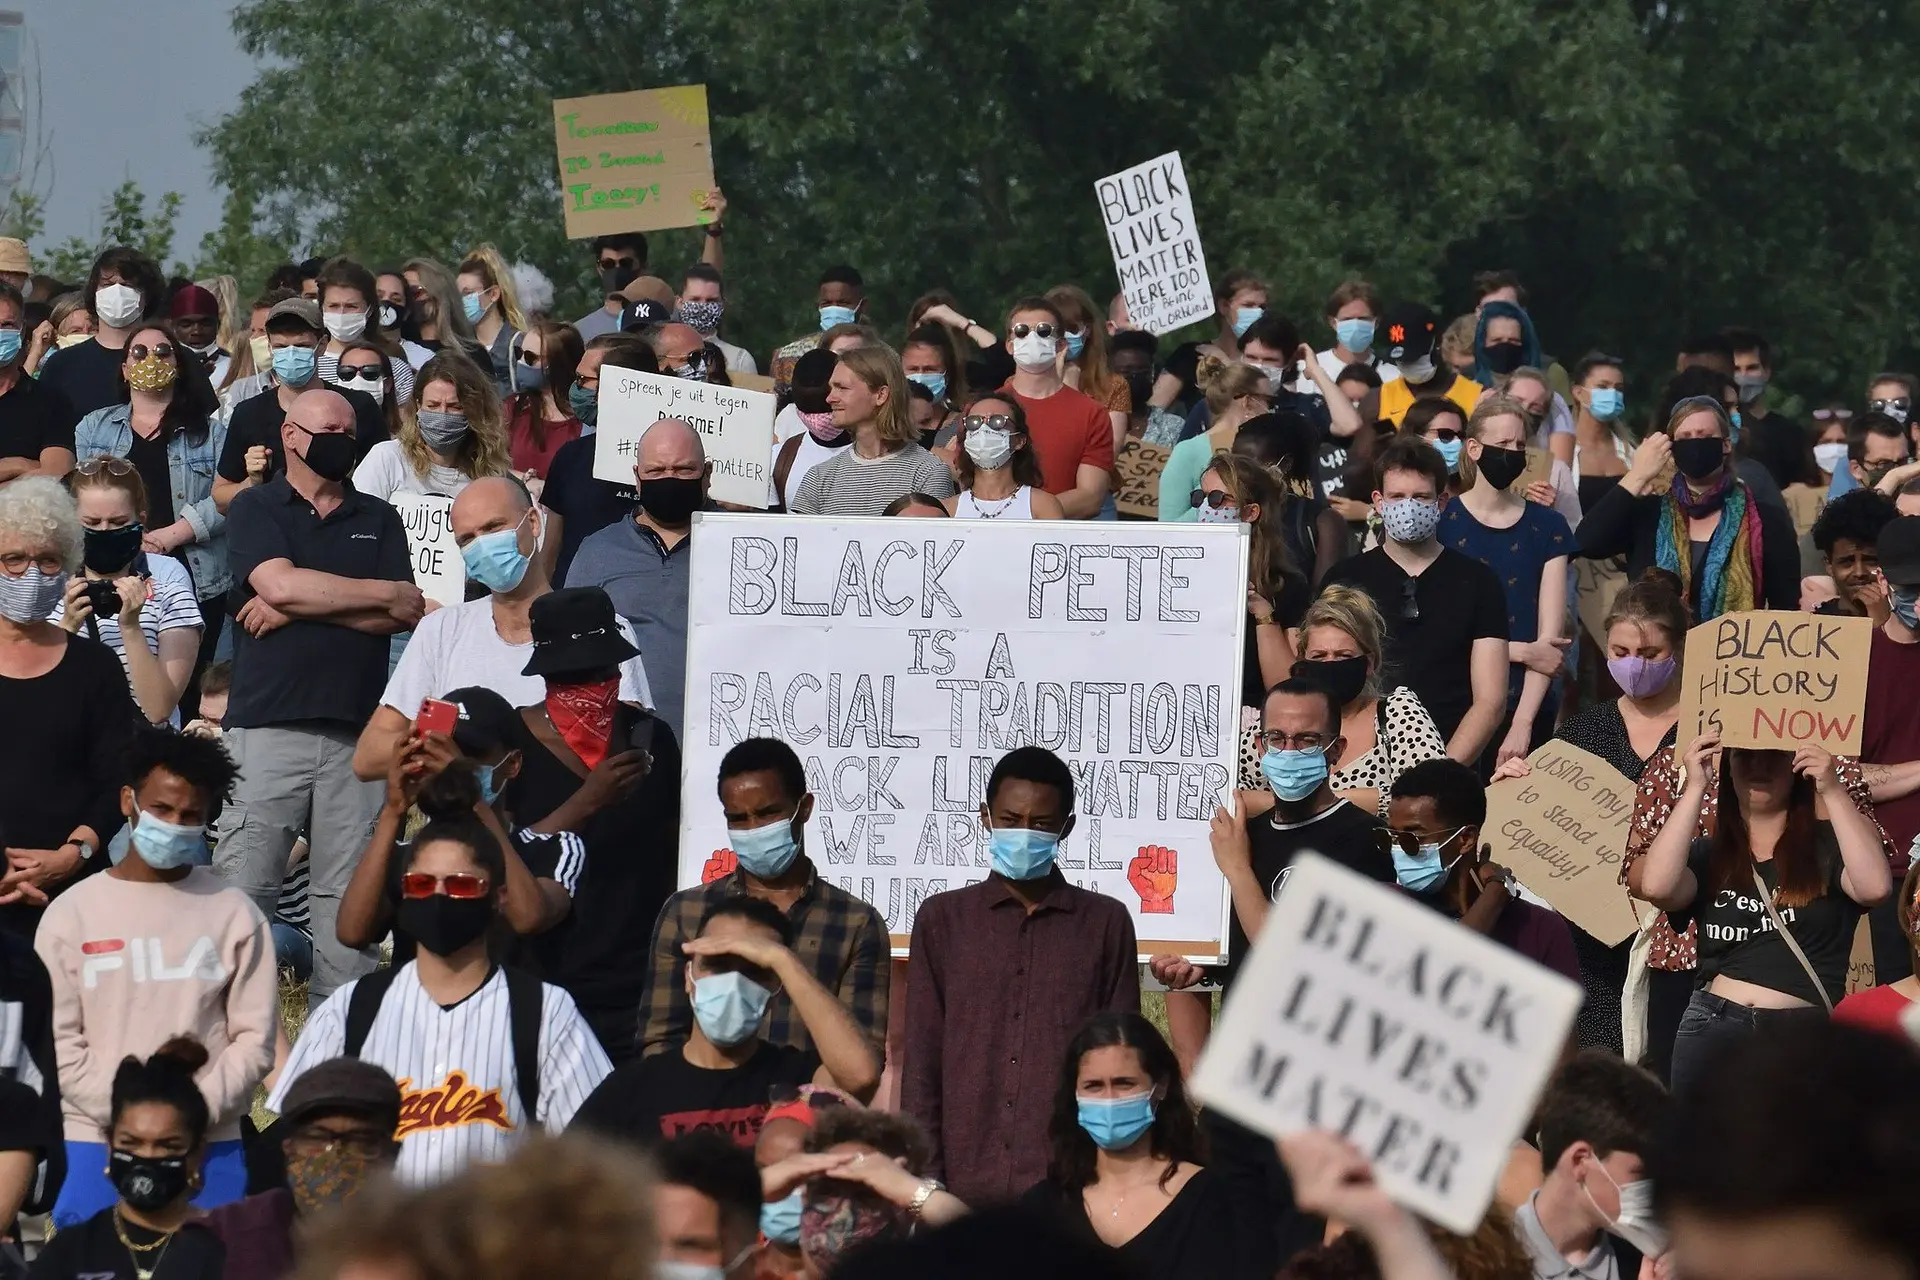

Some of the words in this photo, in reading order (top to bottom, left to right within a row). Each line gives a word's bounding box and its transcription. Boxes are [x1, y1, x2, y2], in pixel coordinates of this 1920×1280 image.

[1100, 160, 1182, 225] BLACK
[1112, 207, 1184, 260] LIVES
[1119, 239, 1198, 290] MATTER
[1124, 279, 1169, 309] HERE
[1170, 268, 1200, 292] TOO
[1130, 302, 1156, 322] STOP
[618, 378, 663, 399] Spreek
[667, 385, 682, 406] je
[689, 390, 705, 403] uit
[715, 394, 748, 415] tegen
[391, 503, 454, 543] wijgt
[729, 536, 965, 618] BLACK
[1028, 543, 1204, 622] PETE
[907, 629, 956, 675] IS
[985, 632, 1015, 678] A
[1716, 618, 1841, 660] BLACK
[709, 672, 920, 748] RACIAL
[936, 678, 1220, 757] TRADITION
[1753, 707, 1856, 742] NOW
[804, 756, 905, 812] ACK
[1591, 787, 1628, 819] my
[820, 813, 896, 867] WE
[1057, 819, 1123, 870] LL
[1501, 819, 1590, 881] equality!
[1516, 785, 1540, 804] to
[1543, 805, 1597, 844] stand
[1596, 845, 1620, 865] up
[1706, 922, 1749, 942] mon
[82, 936, 226, 988] FILA
[1300, 893, 1533, 1049] BLACK
[1849, 958, 1874, 987] ying
[1282, 972, 1489, 1114] LIVES
[392, 1069, 517, 1141] agles
